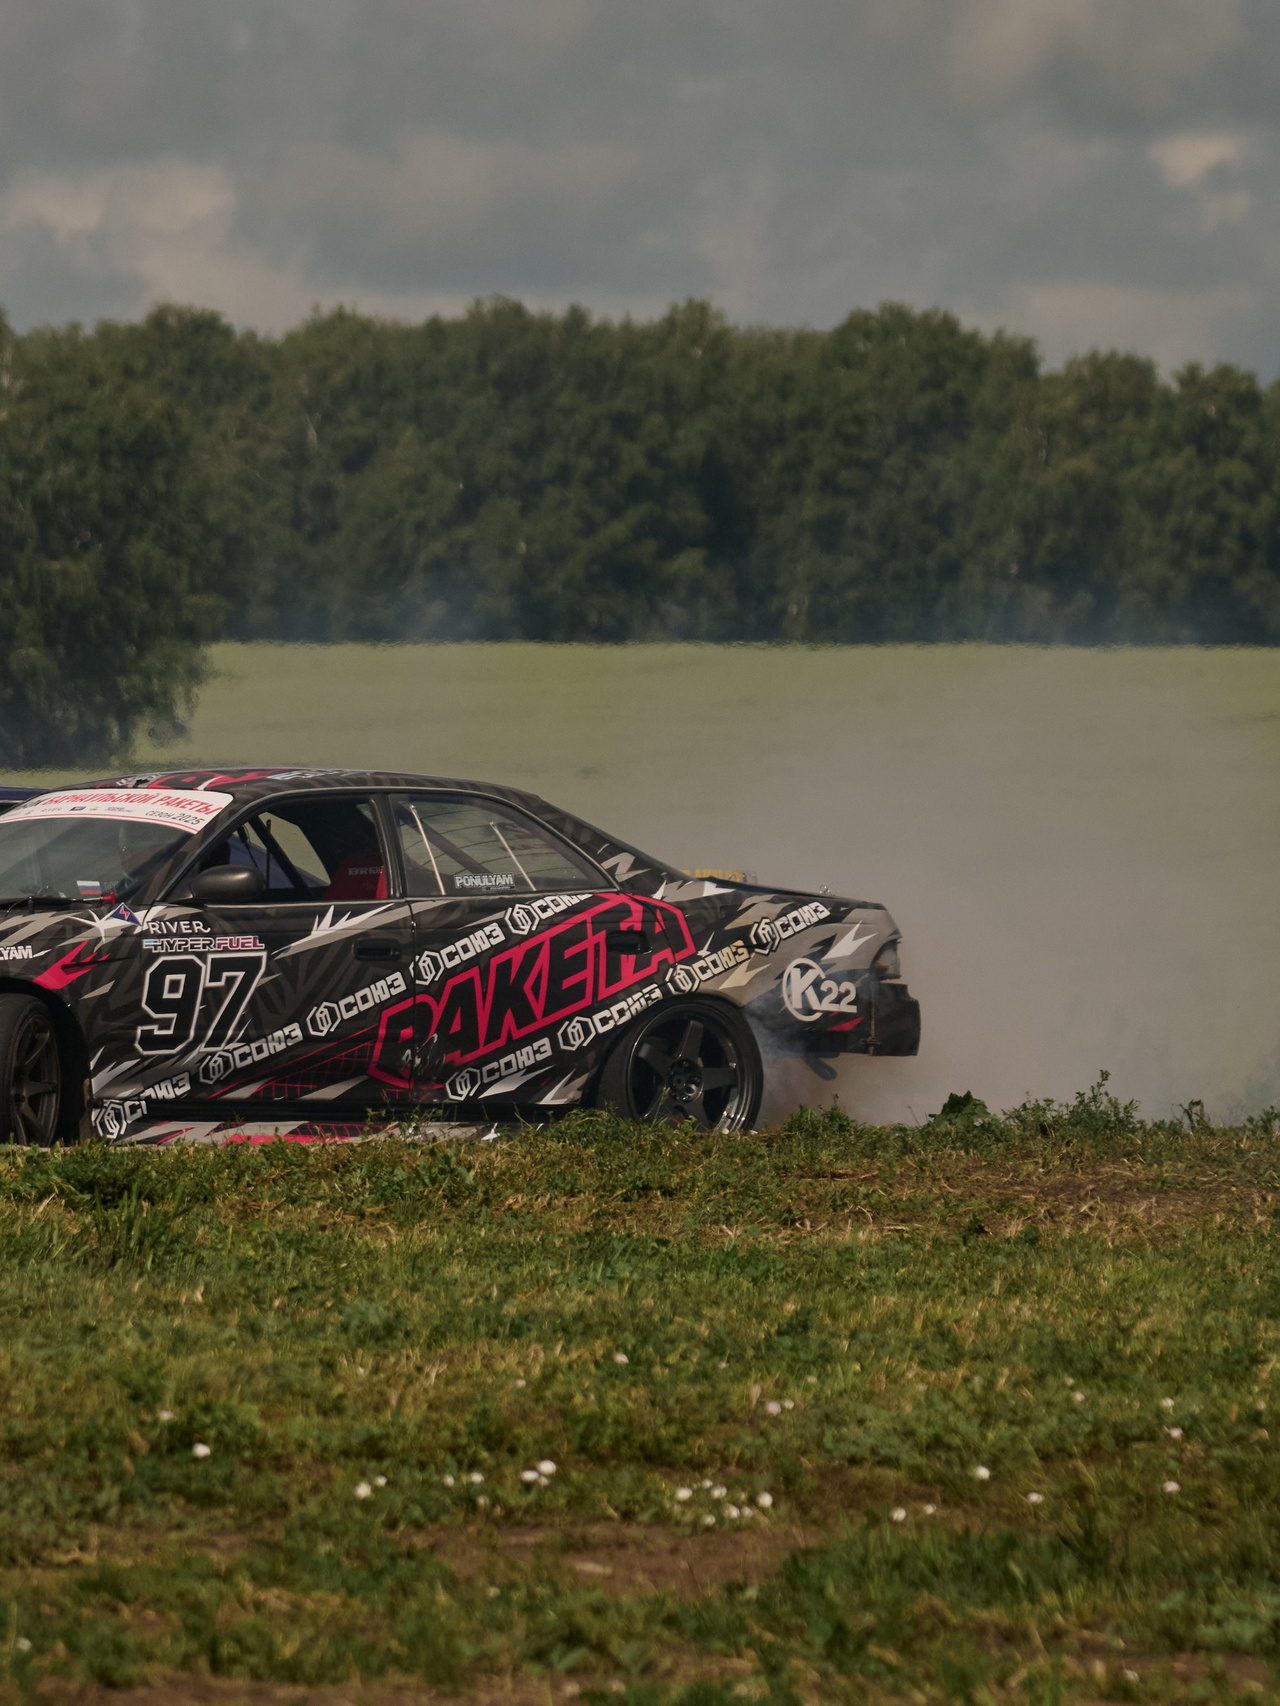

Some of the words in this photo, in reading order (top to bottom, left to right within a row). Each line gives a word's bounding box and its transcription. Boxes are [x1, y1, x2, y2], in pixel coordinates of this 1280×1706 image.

[160, 795, 224, 815] РАКЕТЫ
[145, 810, 173, 820] СЕЗОН
[172, 812, 206, 826] 2025
[455, 874, 514, 889] PONULYAM
[147, 920, 211, 935] RIVER
[234, 1022, 304, 1069] СОЮЗ
[338, 971, 407, 1020] СОЮЗ
[442, 922, 506, 969] СОЮЗ
[482, 1036, 553, 1084] СОЮЗ
[593, 983, 663, 1034] СОЮЗ
[692, 940, 751, 982] СОЮЗ
[776, 901, 831, 940] СОЮЗ
[134, 951, 267, 1056] 97
